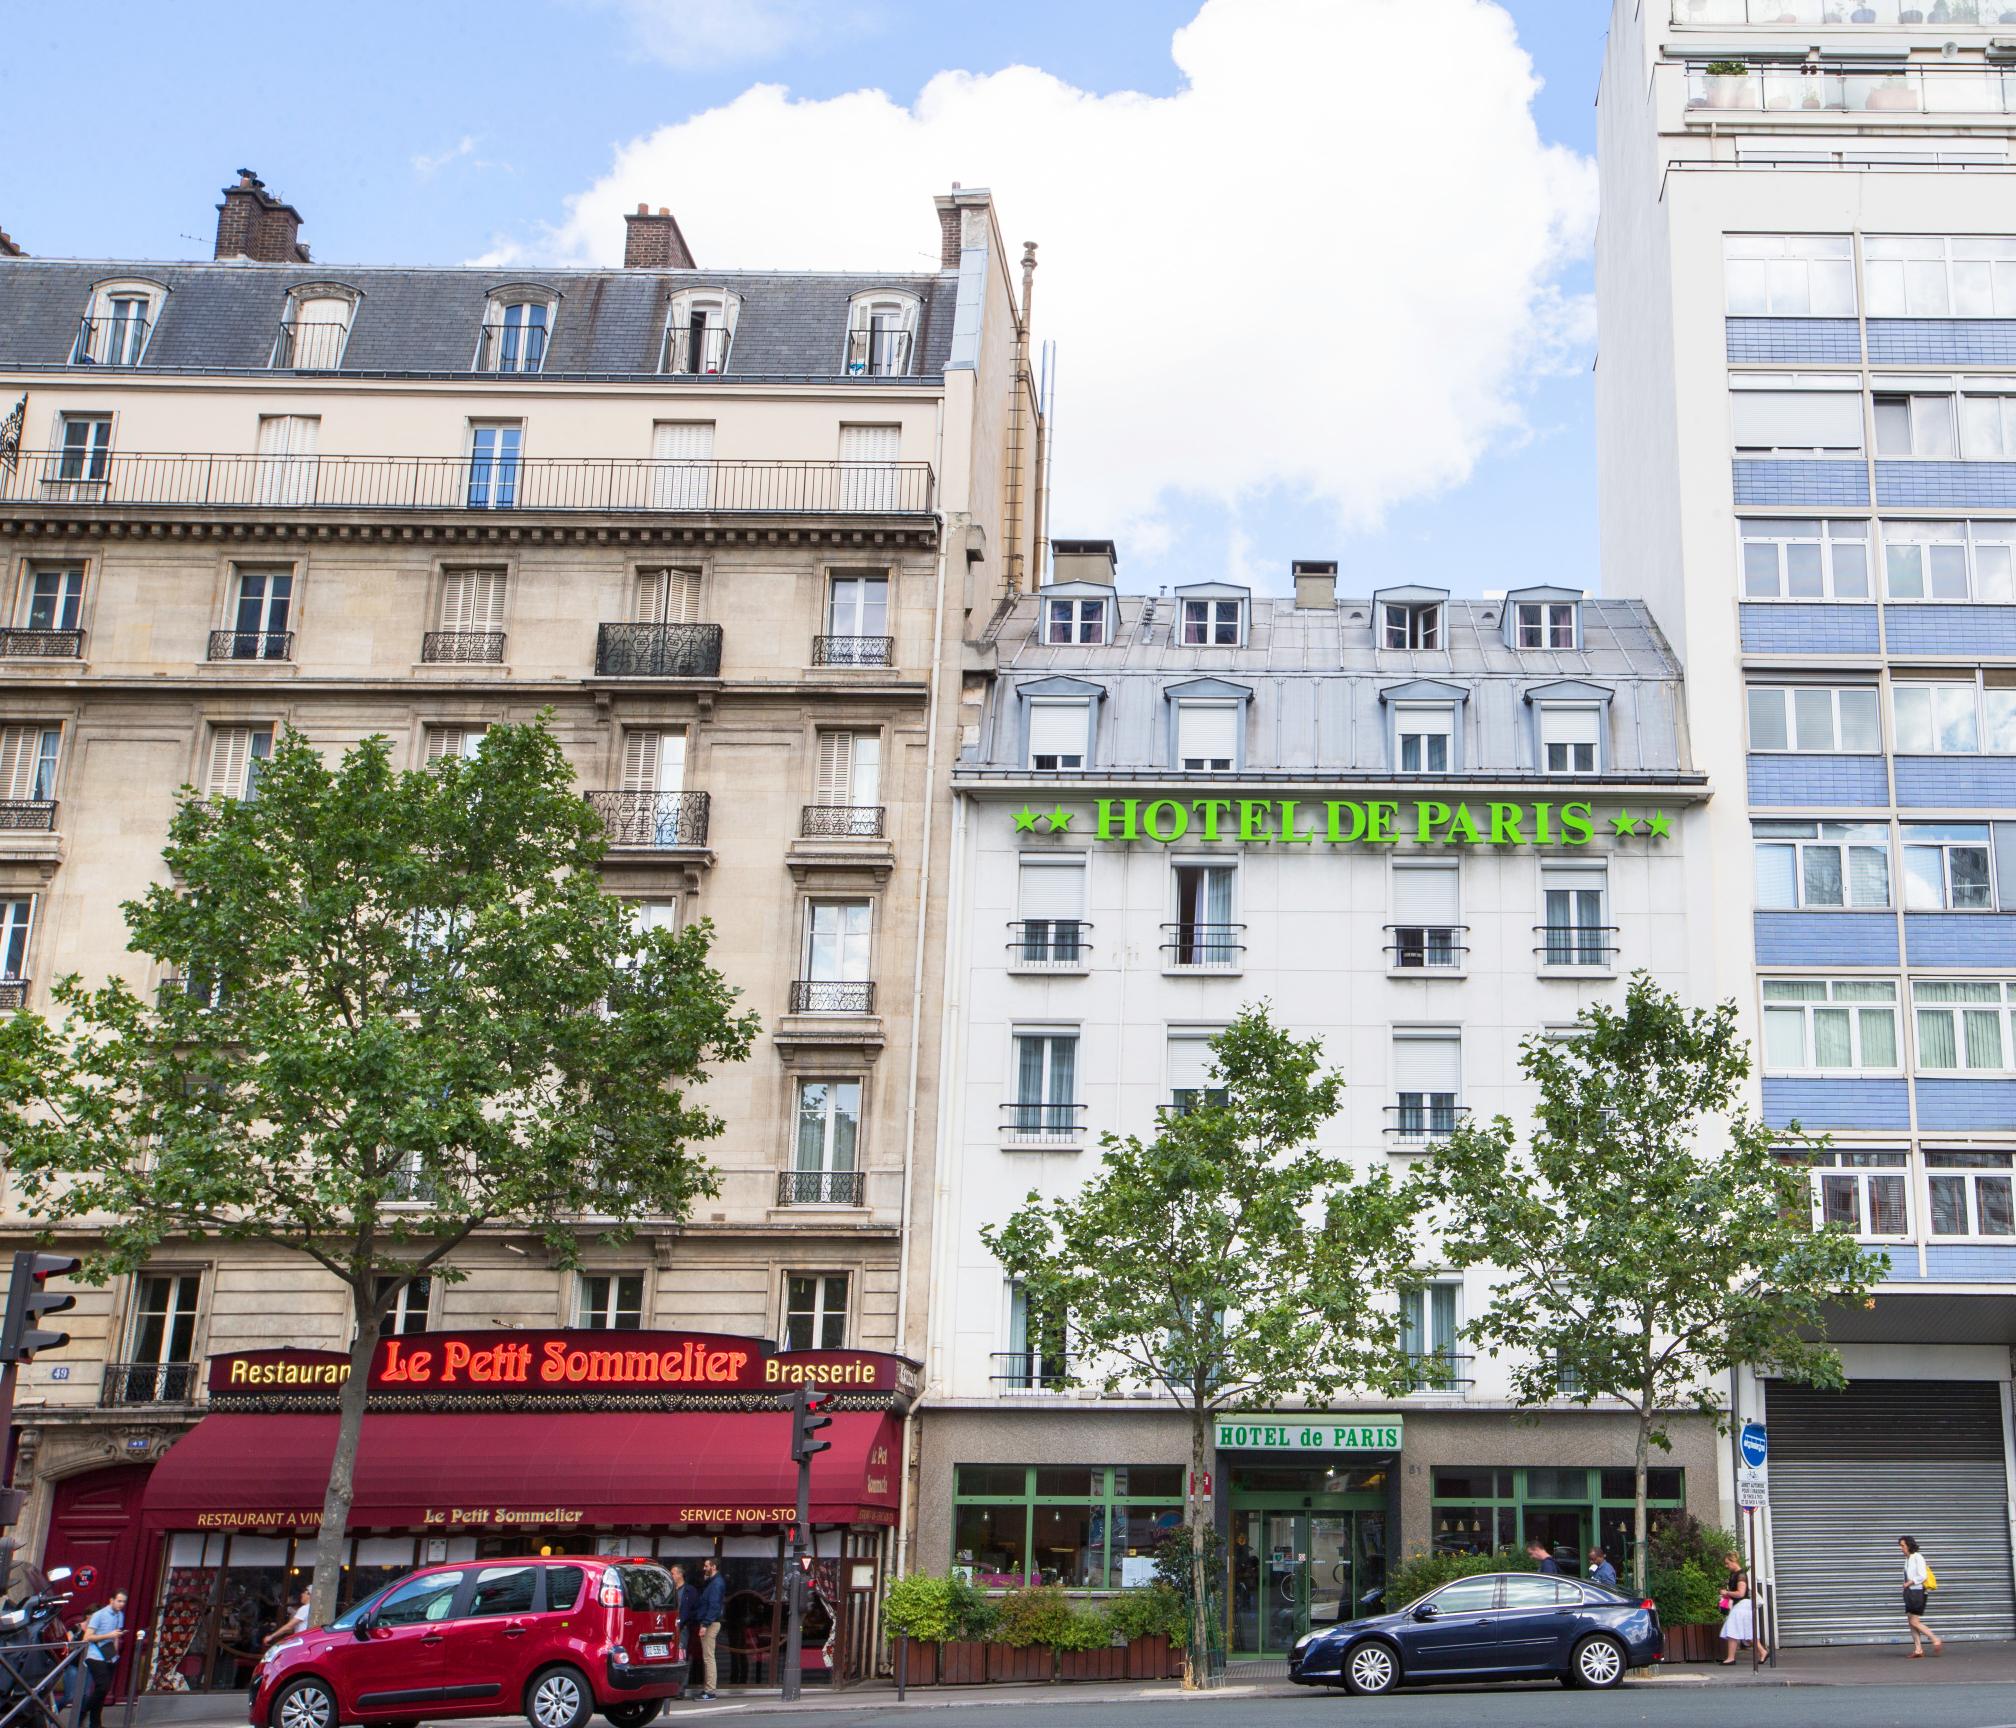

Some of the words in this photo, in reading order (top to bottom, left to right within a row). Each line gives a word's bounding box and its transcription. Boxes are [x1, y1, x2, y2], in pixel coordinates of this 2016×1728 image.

[1093, 799, 1314, 843] HOTEL
[1323, 800, 1400, 843] DE
[1413, 801, 1594, 845] PARIS
[380, 1342, 431, 1381] Le
[440, 1342, 531, 1381] Petit
[540, 1341, 748, 1382] Sommelier
[765, 1360, 876, 1383] Brasserie
[53, 1368, 68, 1379] 49
[231, 1360, 351, 1384] Restauran
[1219, 1427, 1290, 1446] HOTEL
[1300, 1428, 1323, 1446] de
[1334, 1428, 1397, 1447] PARIS
[197, 1513, 284, 1526] RESTAURANT
[286, 1512, 297, 1525] A
[424, 1509, 445, 1523] Le
[451, 1509, 490, 1523] Petit
[494, 1508, 584, 1523] Sommelier
[680, 1509, 732, 1521] SERVICE
[736, 1508, 797, 1521] NON-STO
